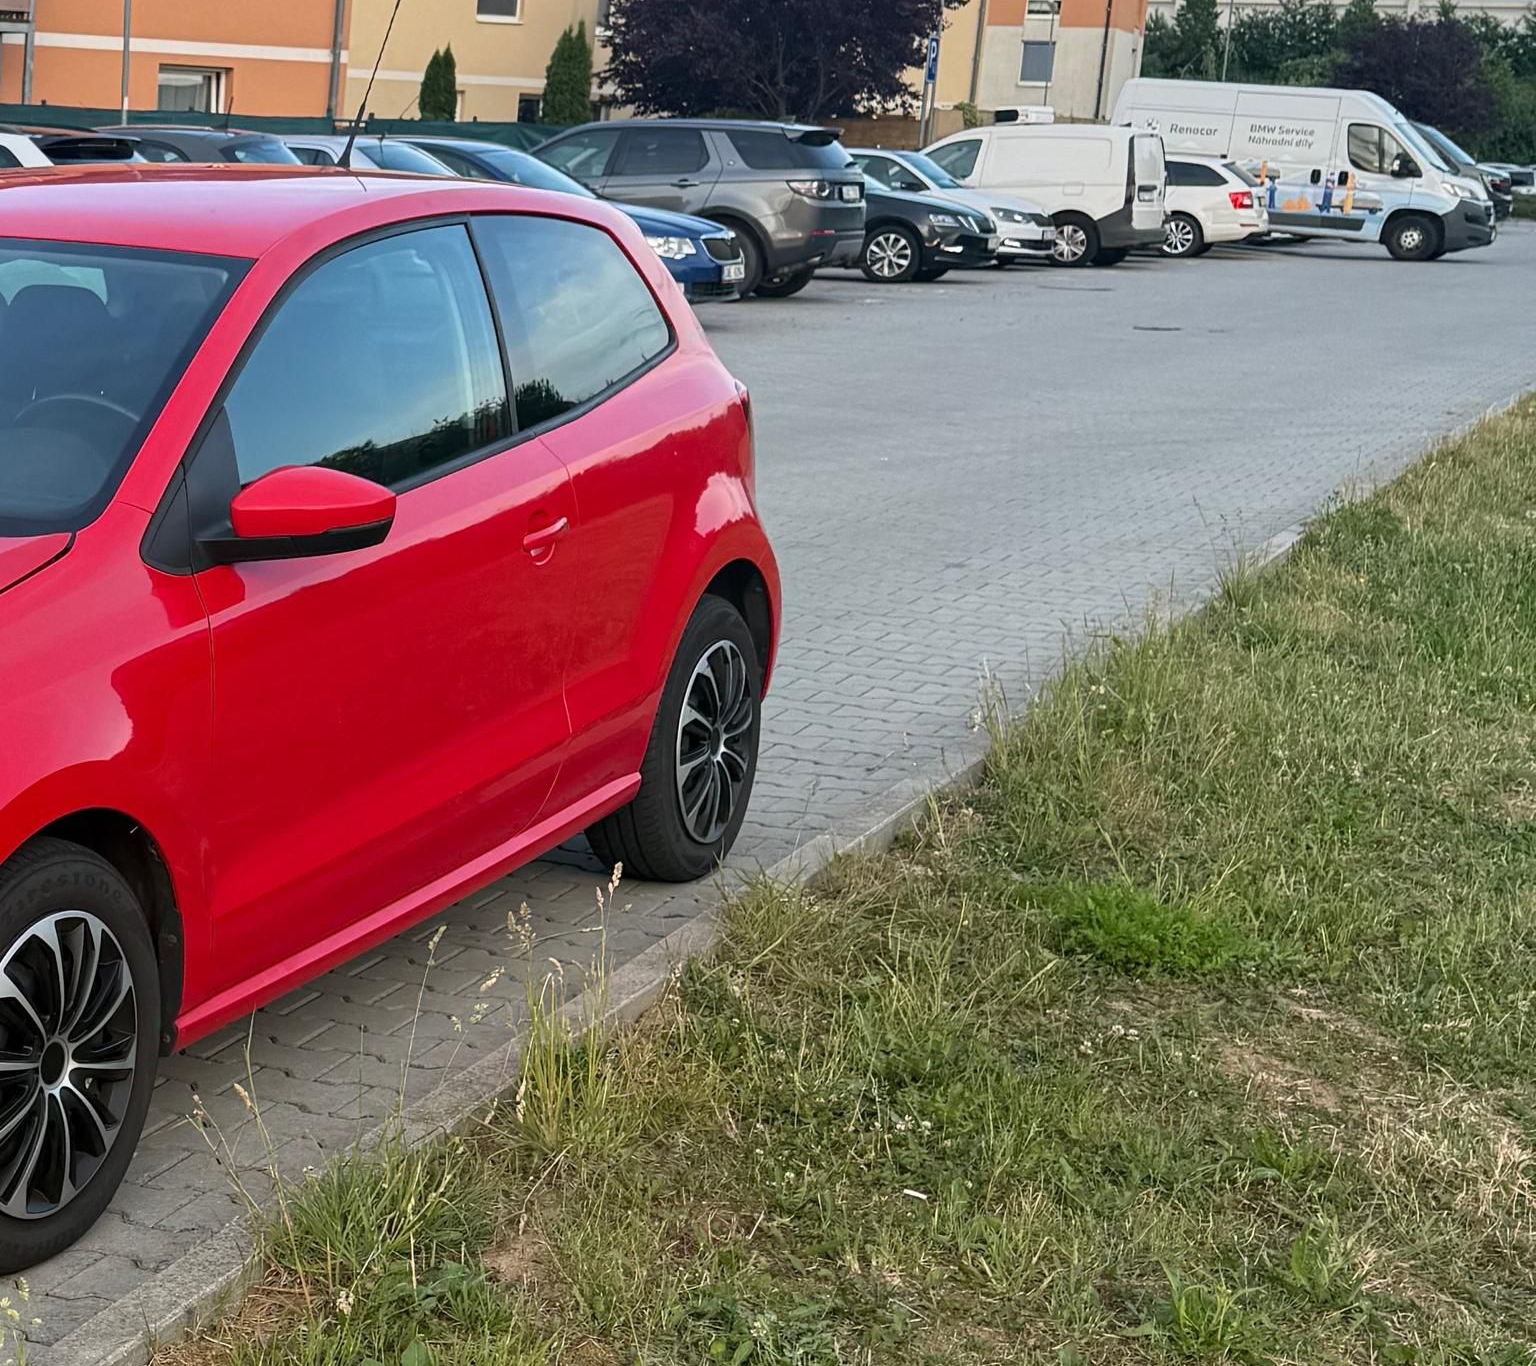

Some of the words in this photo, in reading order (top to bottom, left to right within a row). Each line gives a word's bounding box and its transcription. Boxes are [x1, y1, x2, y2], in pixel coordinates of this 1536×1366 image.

[929, 41, 938, 68] P
[1169, 123, 1219, 137] Renocar
[1249, 123, 1277, 135] BMW
[1278, 125, 1316, 137] Service
